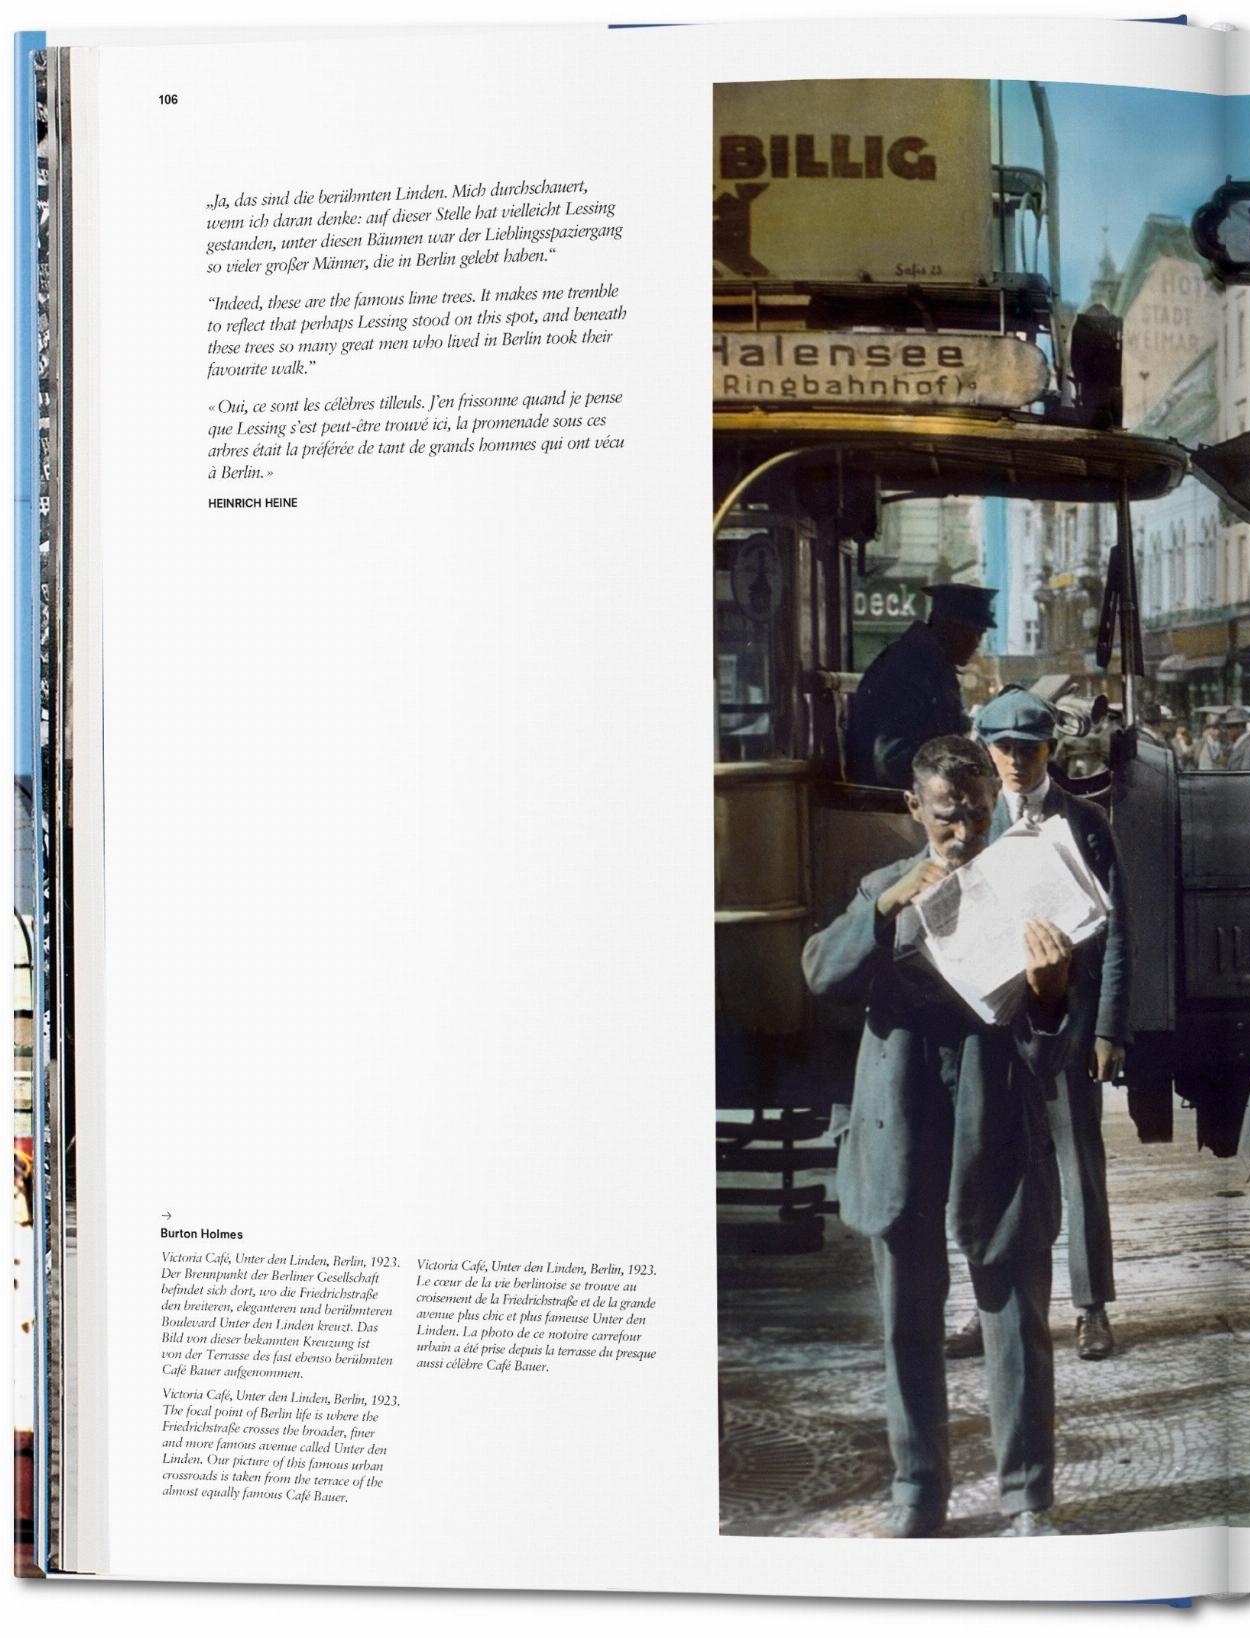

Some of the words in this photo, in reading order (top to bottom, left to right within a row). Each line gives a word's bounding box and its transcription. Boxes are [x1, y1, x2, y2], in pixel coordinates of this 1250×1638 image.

[158, 94, 178, 104] 106
[720, 134, 936, 181] BILLIG
[235, 192, 257, 207] das
[262, 190, 290, 206] sind
[294, 190, 314, 204] die
[319, 188, 391, 204] berühmten
[396, 185, 447, 200] Linden.
[452, 183, 486, 198] Mich
[491, 179, 588, 196] durchschauert,
[207, 219, 244, 229] wenn
[249, 214, 268, 228] ich
[273, 213, 312, 227] daran
[366, 209, 391, 226] auf
[392, 208, 432, 223] dieser
[436, 206, 471, 220] Stelle
[476, 205, 496, 219] hat
[502, 202, 560, 218] vielleicht
[566, 201, 616, 217] Lessing
[206, 236, 276, 254] gestanden,
[282, 237, 317, 249] unter
[321, 233, 362, 247] diesen
[368, 233, 423, 246] Bäumen
[428, 234, 455, 243] war
[459, 228, 481, 242] der
[486, 225, 623, 243] Lieblingsspaziergang
[207, 264, 221, 273] so
[227, 258, 262, 272] vieler
[265, 257, 309, 275] großer
[313, 257, 368, 270] Männer,
[374, 254, 394, 268] die
[398, 254, 411, 267] in
[416, 252, 455, 266] Berlin
[460, 249, 499, 268] gelebt
[268, 295, 301, 309] these
[305, 298, 326, 308] are
[330, 293, 350, 306] the
[354, 292, 404, 309] famous
[409, 291, 438, 304] lime
[442, 292, 475, 303] trees.
[481, 289, 490, 301] It
[496, 286, 538, 301] makes
[542, 290, 563, 299] me
[568, 283, 618, 298] tremble
[208, 321, 221, 332] to
[227, 317, 265, 334] reflect
[270, 317, 296, 330] that
[300, 315, 353, 334] perhaps
[358, 315, 407, 331] Lessing
[412, 312, 450, 326] stood
[455, 316, 472, 325] on
[478, 310, 501, 324] this
[506, 311, 538, 326] spot,
[543, 307, 570, 322] and
[574, 305, 626, 321] beneath
[208, 340, 240, 354] these
[245, 342, 274, 353] trees
[279, 344, 294, 352] so
[299, 342, 337, 355] many
[341, 339, 374, 355] great
[379, 340, 408, 350] men
[413, 334, 443, 348] who
[448, 332, 480, 348] lived
[484, 334, 497, 346] in
[502, 331, 541, 346] Berlin
[546, 330, 577, 344] took
[582, 329, 613, 343] their
[207, 362, 267, 379] favourite
[208, 426, 232, 438] que
[238, 422, 286, 438] Lessing
[321, 419, 380, 436] peut-être
[385, 418, 428, 431] trouvé
[433, 417, 450, 432] ici,
[456, 416, 468, 430] la
[472, 413, 549, 433] promenade
[553, 417, 582, 427] sous
[587, 417, 606, 426] ces
[208, 498, 261, 508] HEINRICH
[265, 498, 298, 508] HEINE
[161, 1228, 197, 1238] Burton
[201, 1228, 243, 1239] Holmes
[163, 1252, 202, 1262] Victoria
[236, 1253, 265, 1263] Unter
[268, 1254, 286, 1264] den
[418, 1259, 458, 1270] Victoria
[492, 1261, 521, 1272] Unter
[524, 1262, 543, 1272] den
[446, 1358, 482, 1369] célèbre
[487, 1359, 511, 1372] Café
[164, 1388, 203, 1399] Victoria
[237, 1390, 266, 1401] Unter
[268, 1391, 287, 1402] den
[283, 1425, 299, 1436] the
[351, 1427, 375, 1440] finer
